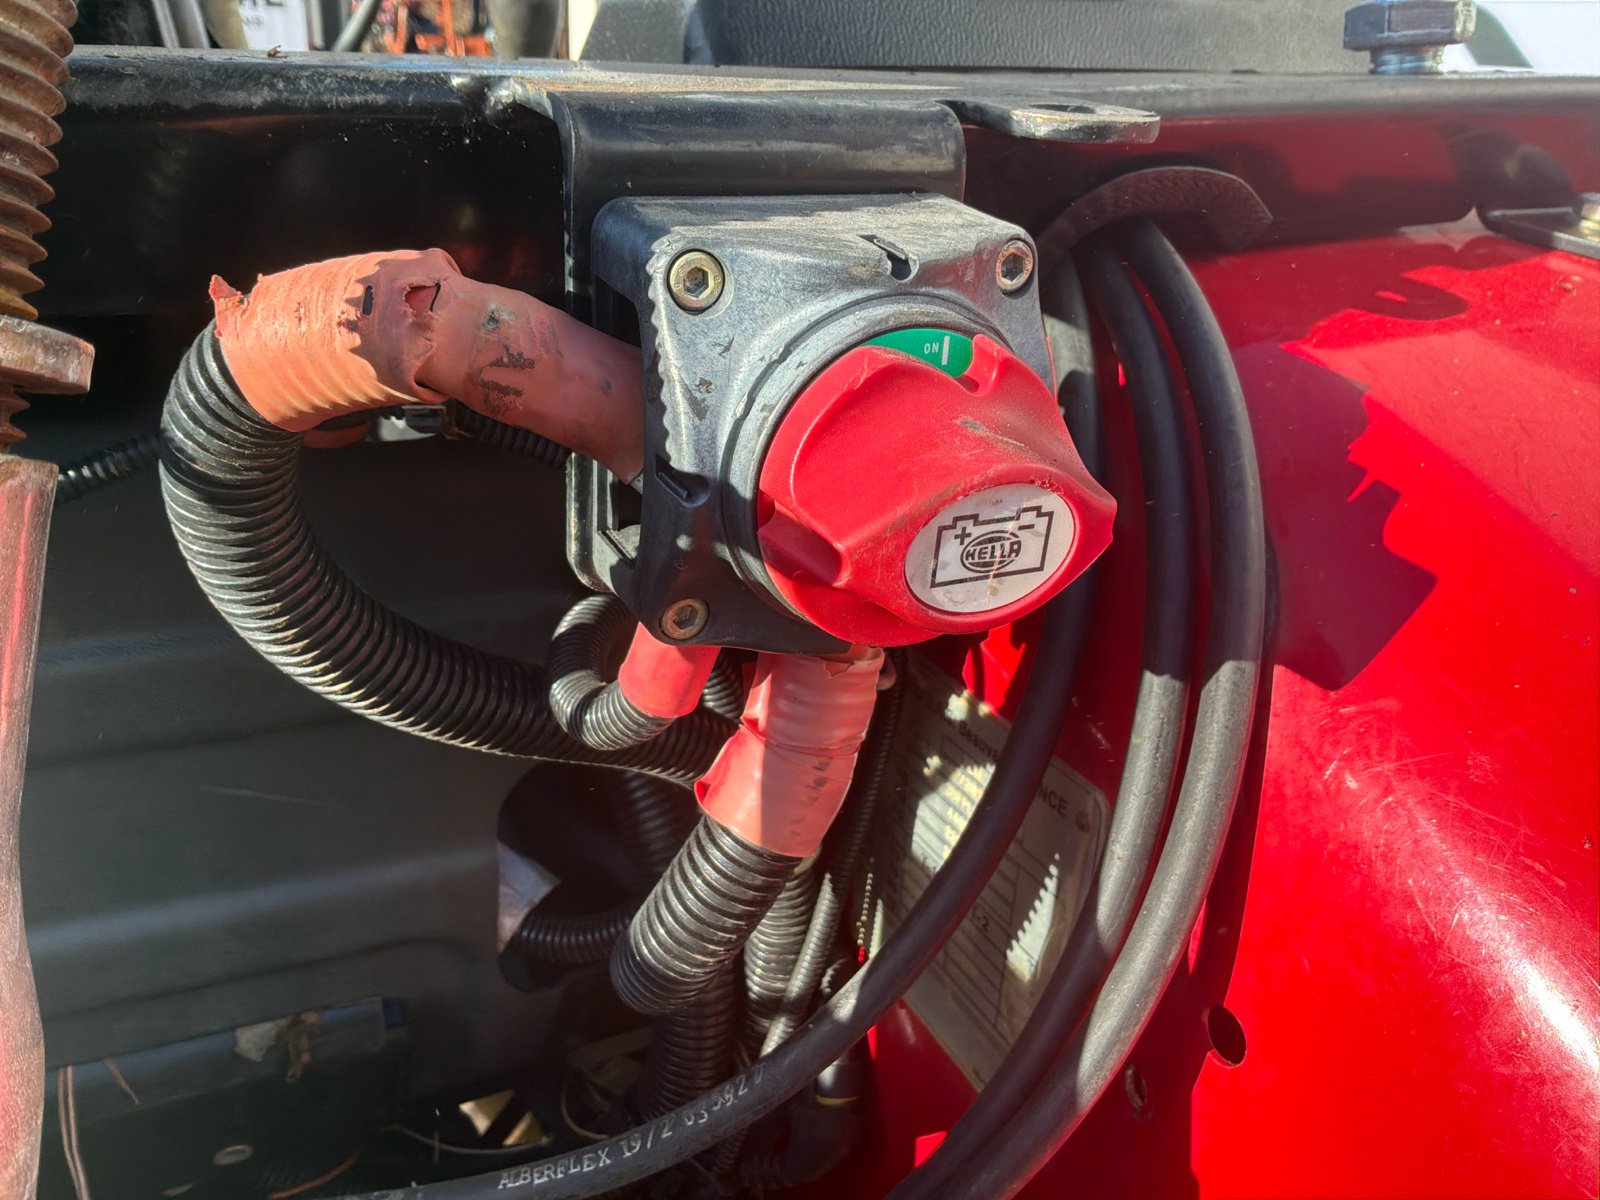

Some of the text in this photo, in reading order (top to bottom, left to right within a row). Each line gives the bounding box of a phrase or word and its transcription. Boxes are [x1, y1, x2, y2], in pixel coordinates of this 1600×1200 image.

[923, 342, 939, 354] ON
[964, 539, 1022, 561] HELLA
[497, 1147, 612, 1189] ALBERFLEX
